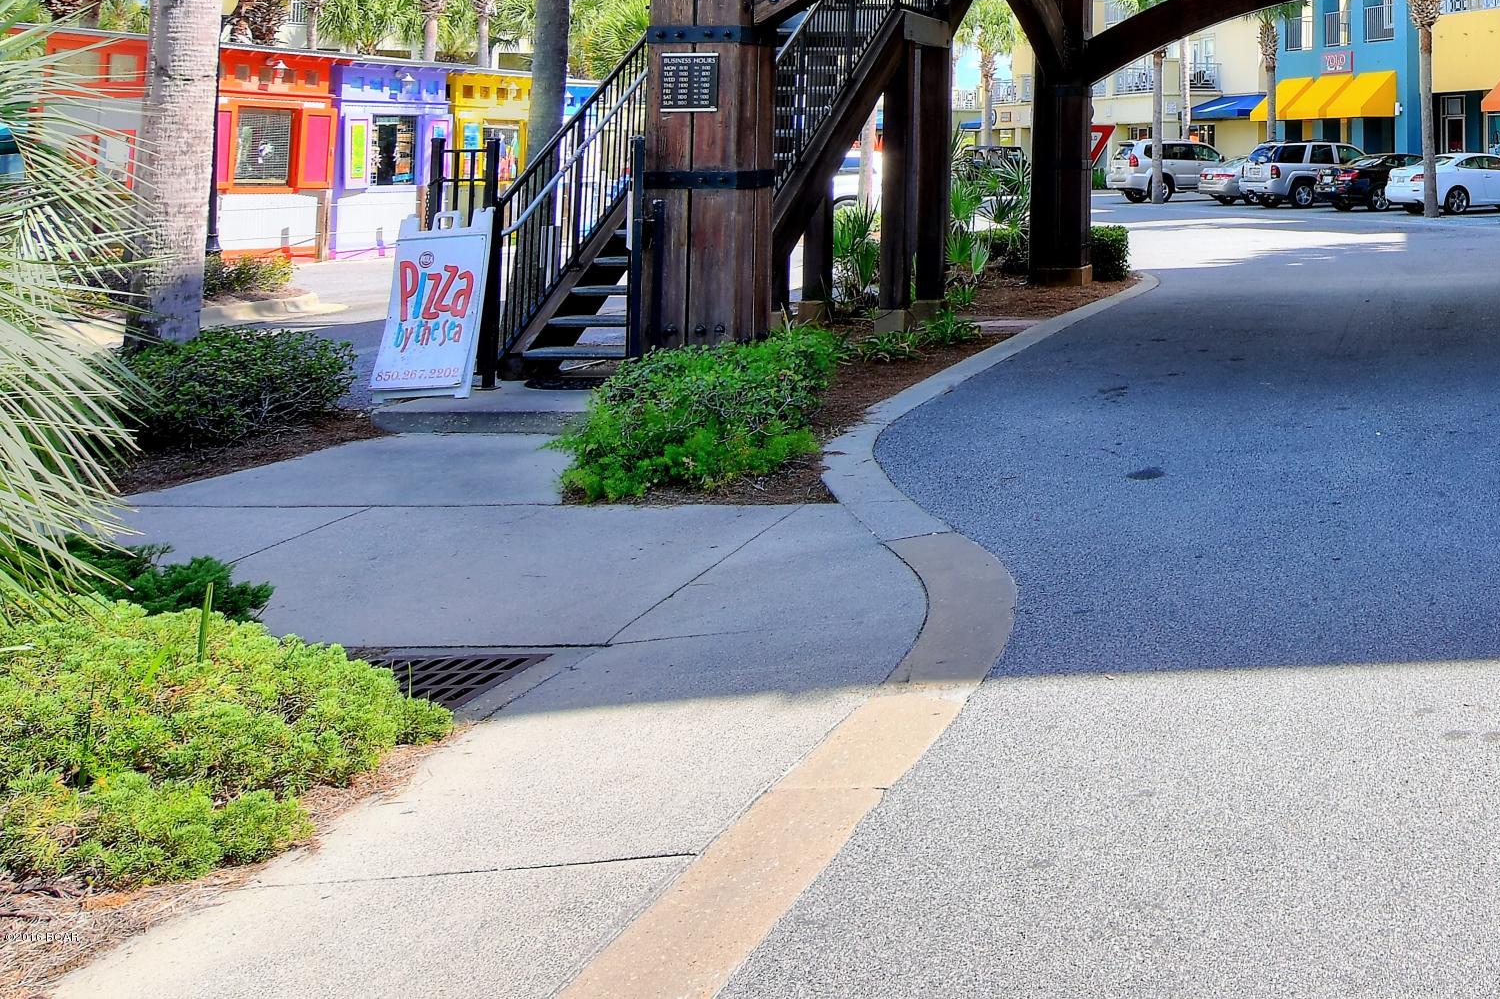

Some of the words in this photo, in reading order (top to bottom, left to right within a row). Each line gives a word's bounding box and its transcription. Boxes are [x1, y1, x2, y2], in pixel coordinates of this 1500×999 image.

[400, 259, 474, 322] Pizza
[393, 322, 414, 353] by
[414, 320, 440, 346] the
[375, 367, 459, 382] 850.267.2202
